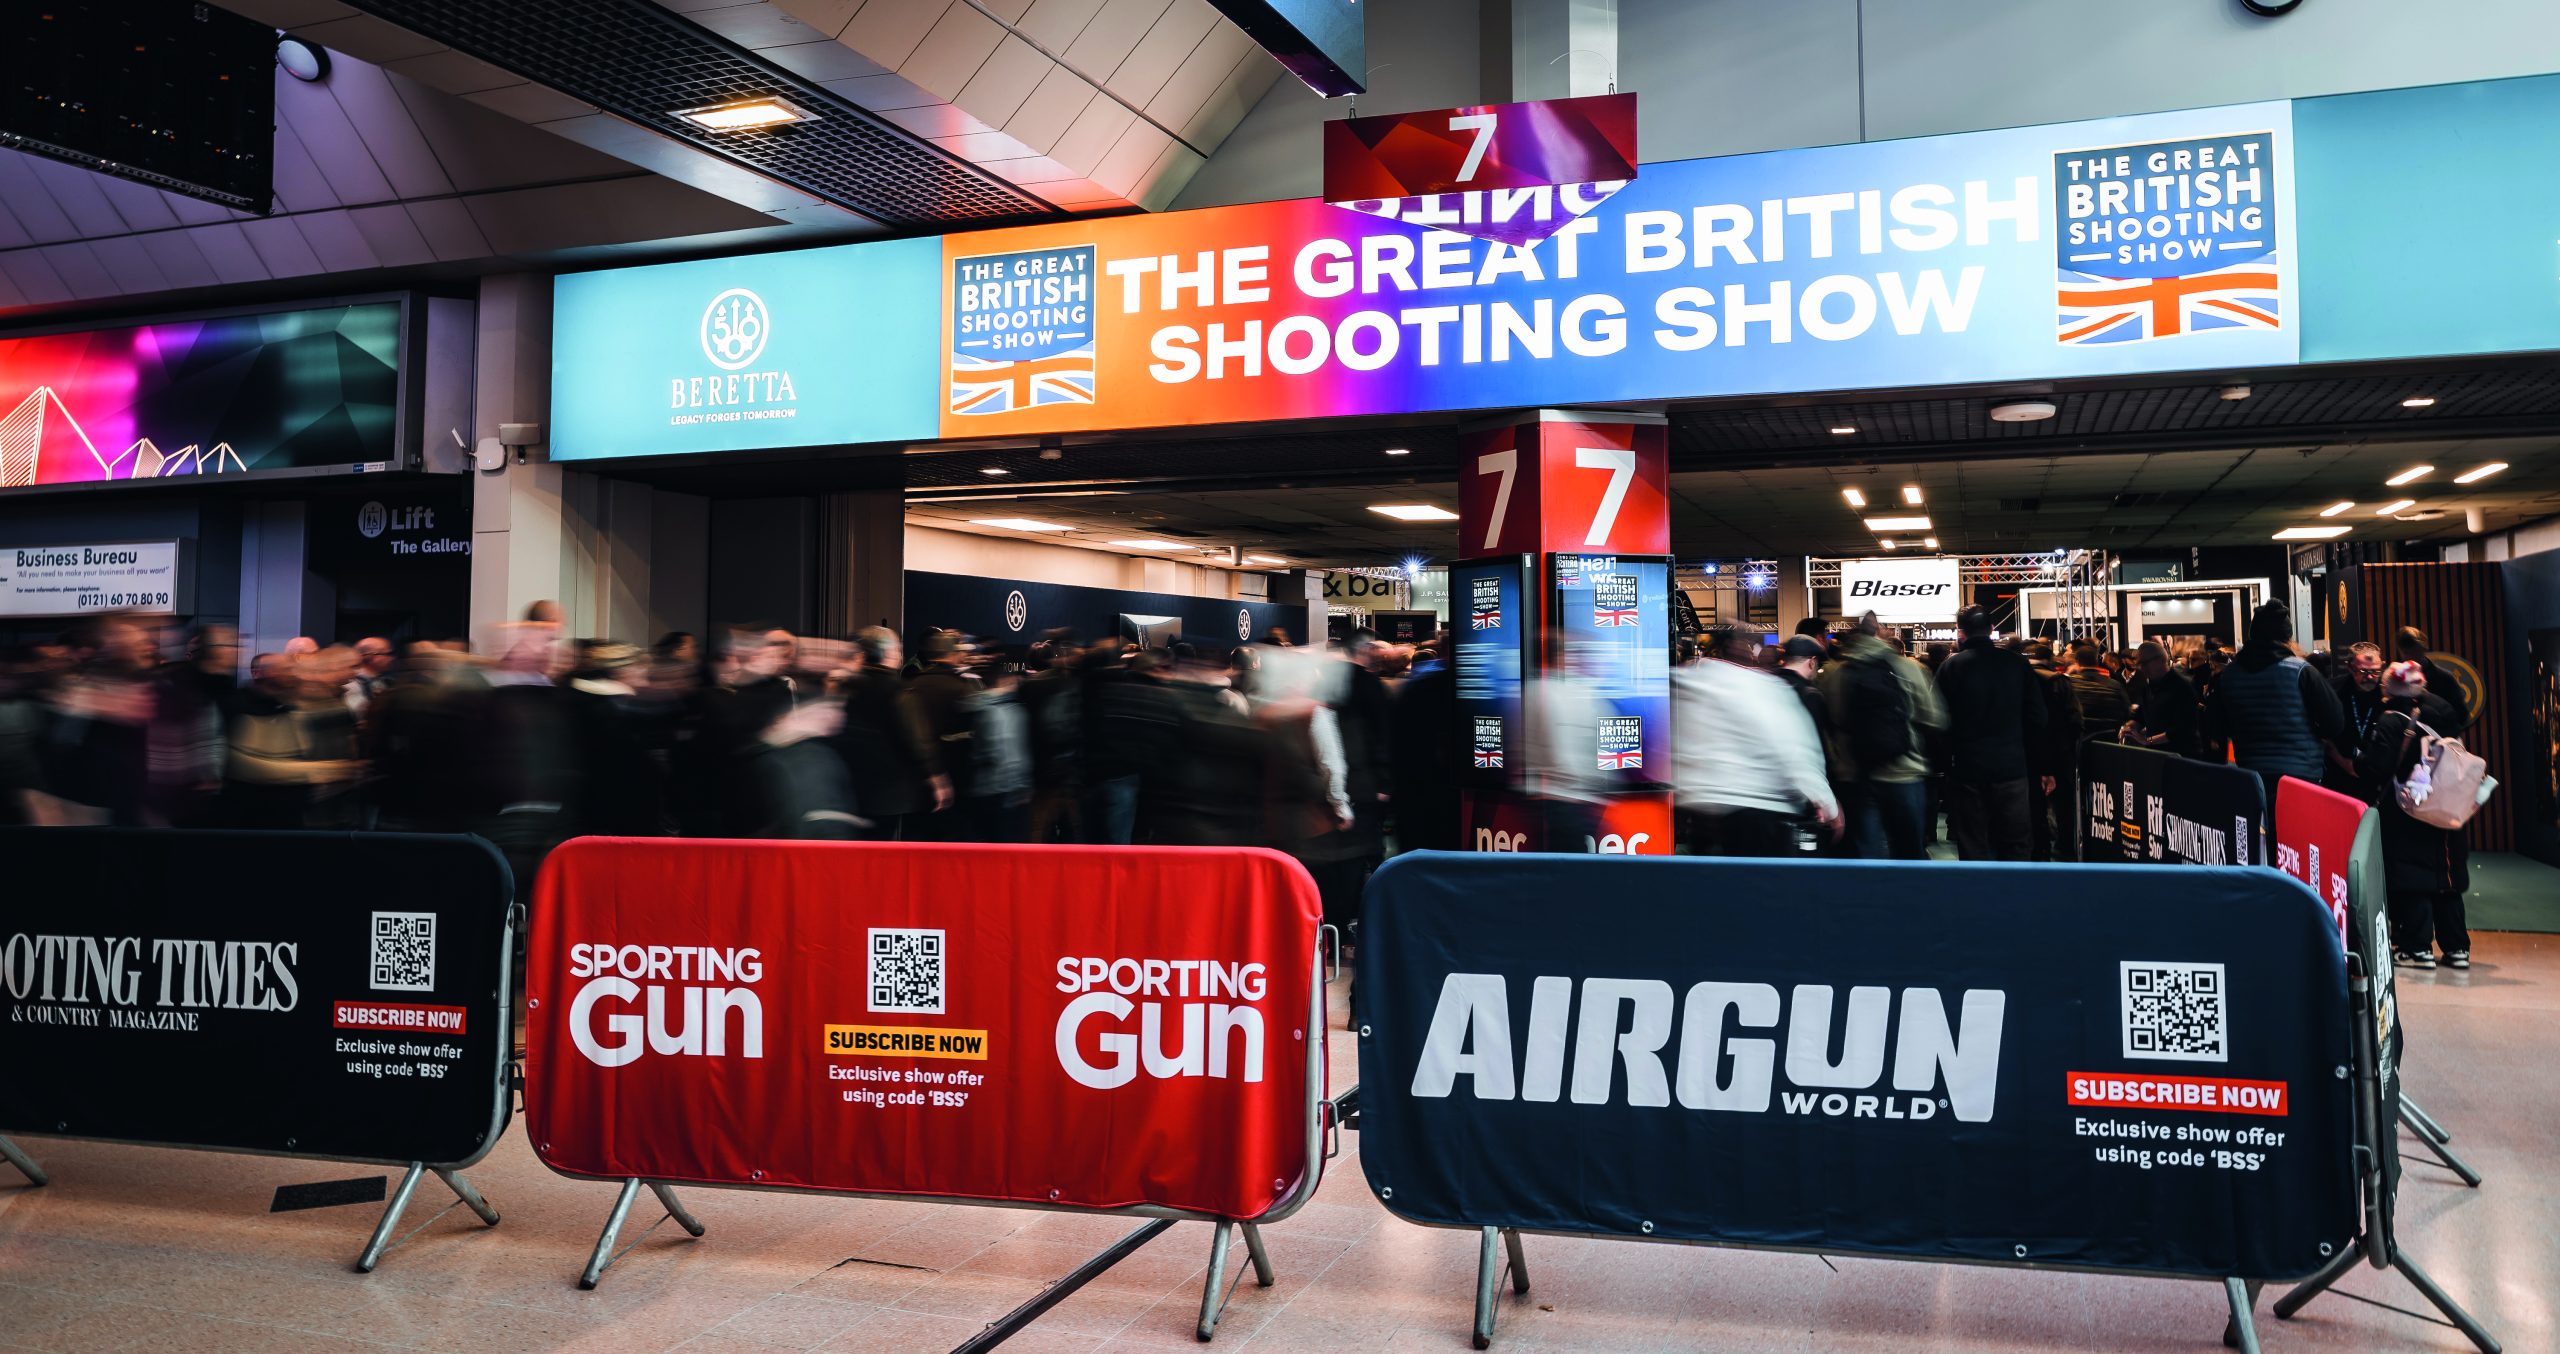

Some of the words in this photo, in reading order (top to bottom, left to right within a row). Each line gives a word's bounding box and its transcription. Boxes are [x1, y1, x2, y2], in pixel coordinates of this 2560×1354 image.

[1449, 113, 1497, 182] 7
[2067, 155, 2131, 181] THE
[2148, 142, 2260, 173] GREAT
[2067, 167, 2262, 219] BRITISH
[2068, 206, 2262, 245] SHOOTING
[1106, 245, 1271, 314] THE
[1293, 216, 1599, 298] GREAT
[1624, 175, 2039, 274] BRITISH
[2118, 238, 2212, 265] SHOW
[962, 262, 1004, 282] THE
[1013, 254, 1087, 277] GREAT
[961, 273, 1087, 312] BRITISH
[961, 305, 1086, 334] SHOOTING
[1149, 294, 1627, 384] SHOOTING
[1653, 265, 1985, 352] SHOW
[992, 329, 1054, 350] SHOW
[670, 370, 797, 409] BERETTA
[670, 414, 705, 426] LEGACY
[706, 412, 741, 423] FORGES
[743, 408, 797, 420] TOMORROW
[1479, 448, 1517, 550] 7
[1575, 447, 1636, 546] 7
[391, 506, 435, 530] Lift
[17, 548, 79, 568] Business
[83, 547, 138, 566] Bureau
[391, 540, 418, 554] The
[422, 538, 472, 555] Gallery
[29, 571, 40, 579] you
[41, 570, 56, 578] need
[58, 570, 64, 578] to
[65, 569, 82, 577] make
[84, 570, 97, 579] your
[137, 569, 148, 577] you
[78, 593, 108, 608] (0121)
[111, 594, 123, 606] 60
[126, 593, 138, 605] 70
[141, 593, 153, 605] 80
[156, 592, 169, 604] 90
[1473, 587, 1499, 598] BRITISH
[1473, 597, 1499, 605] SHOOTING
[1596, 584, 1636, 594] BRITISH
[1850, 580, 1951, 597] Blaser
[1475, 726, 1501, 735] BRITISH
[1599, 726, 1639, 736] BRITISH
[2166, 813, 2201, 863] SHOOTING
[2201, 825, 2227, 866] TIMES
[0, 933, 142, 1006] OTING
[152, 938, 299, 1012] TIMES
[569, 943, 764, 983] SPORTING
[1055, 956, 1267, 1001] SPORTING
[12, 1003, 23, 1022] &
[27, 1005, 102, 1027] COUNTRY
[109, 1009, 199, 1032] MAGAZINE
[337, 1006, 426, 1027] SUBSCRIBE
[427, 1010, 463, 1029] NOW
[569, 975, 764, 1068] Gun
[335, 1037, 396, 1055] Exclusive
[398, 1041, 432, 1057] show
[433, 1043, 463, 1059] offer
[829, 1031, 936, 1052] SUBSCRIBE
[939, 1035, 982, 1054] NOW
[1055, 991, 1265, 1090] Gun
[1411, 972, 2006, 1123] AIRGUN
[346, 1059, 383, 1078] using
[385, 1062, 414, 1077] code
[828, 1064, 901, 1082] Exclusive
[904, 1067, 945, 1084] show
[947, 1069, 985, 1086] offer
[842, 1087, 886, 1109] using
[887, 1089, 926, 1105] code
[2073, 1078, 2217, 1106] SUBSCRIBE
[2221, 1085, 2281, 1110] NOW
[2074, 1117, 2171, 1140] Exclusive
[2176, 1122, 2231, 1143] show
[2235, 1126, 2286, 1147] offer
[2095, 1144, 2152, 1170] using
[2156, 1148, 2205, 1167] code
